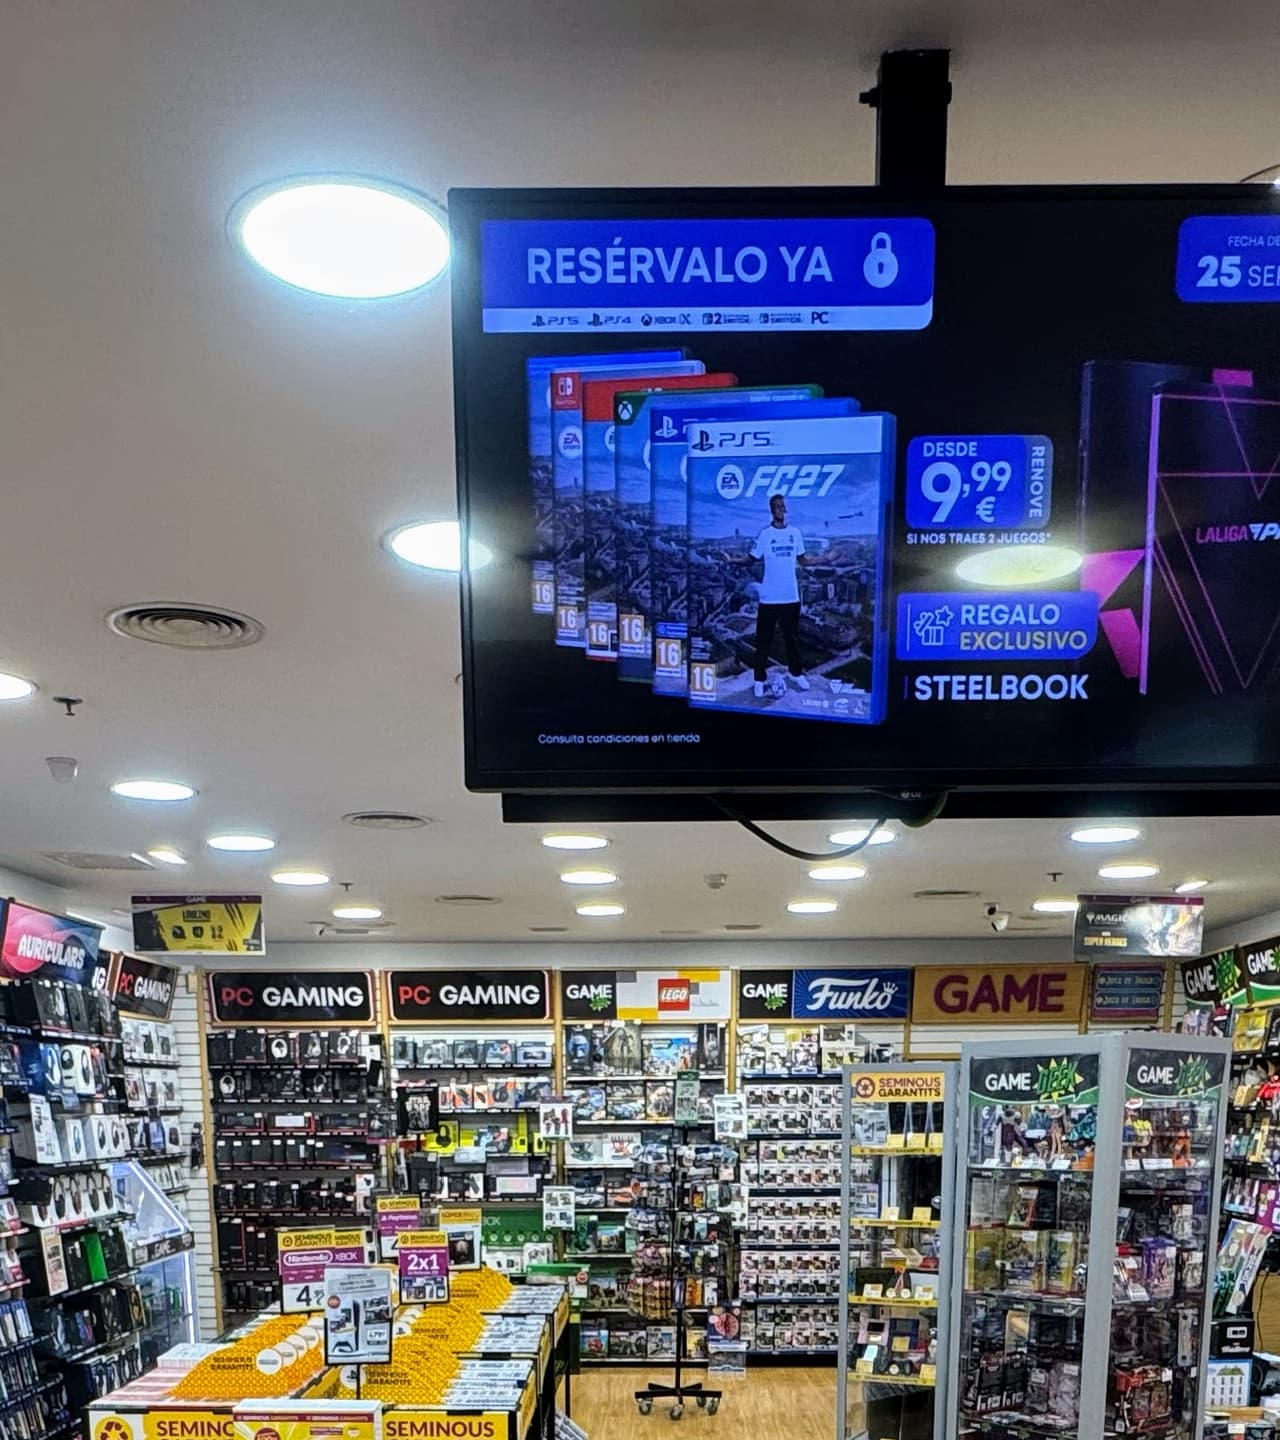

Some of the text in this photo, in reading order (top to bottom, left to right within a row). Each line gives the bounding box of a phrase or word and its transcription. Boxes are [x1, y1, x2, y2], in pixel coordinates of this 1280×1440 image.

[1228, 236, 1264, 247] FECHA
[1267, 236, 1280, 247] DE
[527, 237, 833, 284] RESÉRVALO YA
[1196, 255, 1241, 288] 25
[810, 312, 829, 325] PC
[719, 431, 772, 448] PS5
[923, 442, 978, 457] DESDE
[745, 464, 845, 497] FC27
[1029, 446, 1045, 518] RENOVE
[906, 533, 917, 544] SI
[921, 533, 946, 544] NOS
[950, 533, 985, 544] TRAES
[988, 533, 995, 544] 2
[960, 604, 1060, 626] REGALO
[959, 630, 1088, 650] EXCLUSIVO
[914, 674, 1088, 701] STEELBOOK
[538, 733, 700, 744] Consulta condiciones en tienda
[17, 933, 85, 971] AURICULARS
[1247, 948, 1275, 975] GAME
[119, 973, 170, 1003] PC GAMING
[1186, 964, 1216, 995] GAME
[221, 986, 364, 1008] PC GAMING
[399, 984, 540, 1006] PC GAMING
[566, 983, 613, 1000] GAME
[660, 985, 689, 1004] LEGO
[743, 981, 789, 1002] GAME
[806, 977, 895, 1012] Funko
[933, 973, 1066, 1014] GAME
[879, 1077, 941, 1088] SEMINOUS
[985, 1072, 1031, 1093] GAME
[1137, 1065, 1173, 1085] GAME
[878, 1087, 941, 1097] GARANTITS
[407, 1254, 440, 1270] 2x1
[156, 1420, 235, 1438] SEMIN
[385, 1420, 495, 1438] SEMINOUS
